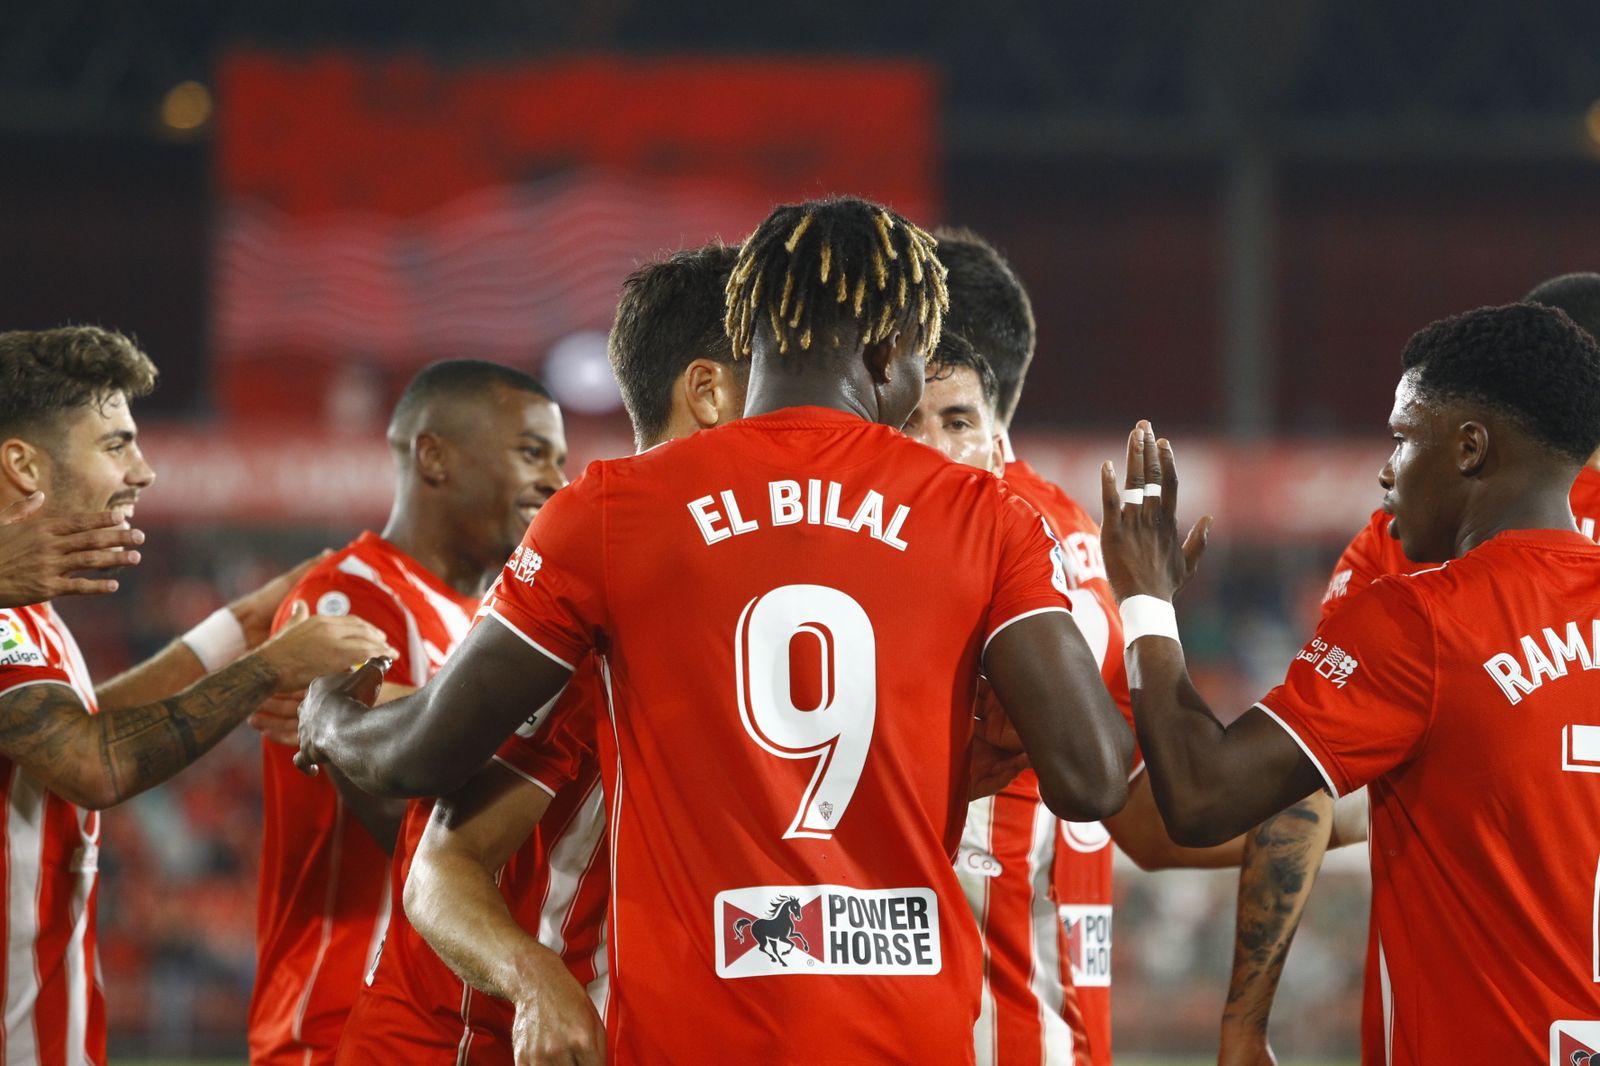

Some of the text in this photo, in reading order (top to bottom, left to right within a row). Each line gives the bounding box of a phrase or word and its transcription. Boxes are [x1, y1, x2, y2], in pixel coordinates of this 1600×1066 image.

[687, 478, 911, 552] EL BILAL
[0, 650, 39, 665] aLiga
[1483, 619, 1600, 705] RAM
[735, 584, 877, 840] 9
[828, 894, 930, 930] POWER
[1085, 915, 1112, 943] PO
[830, 930, 933, 966] HORSE
[1086, 947, 1109, 976] HO
